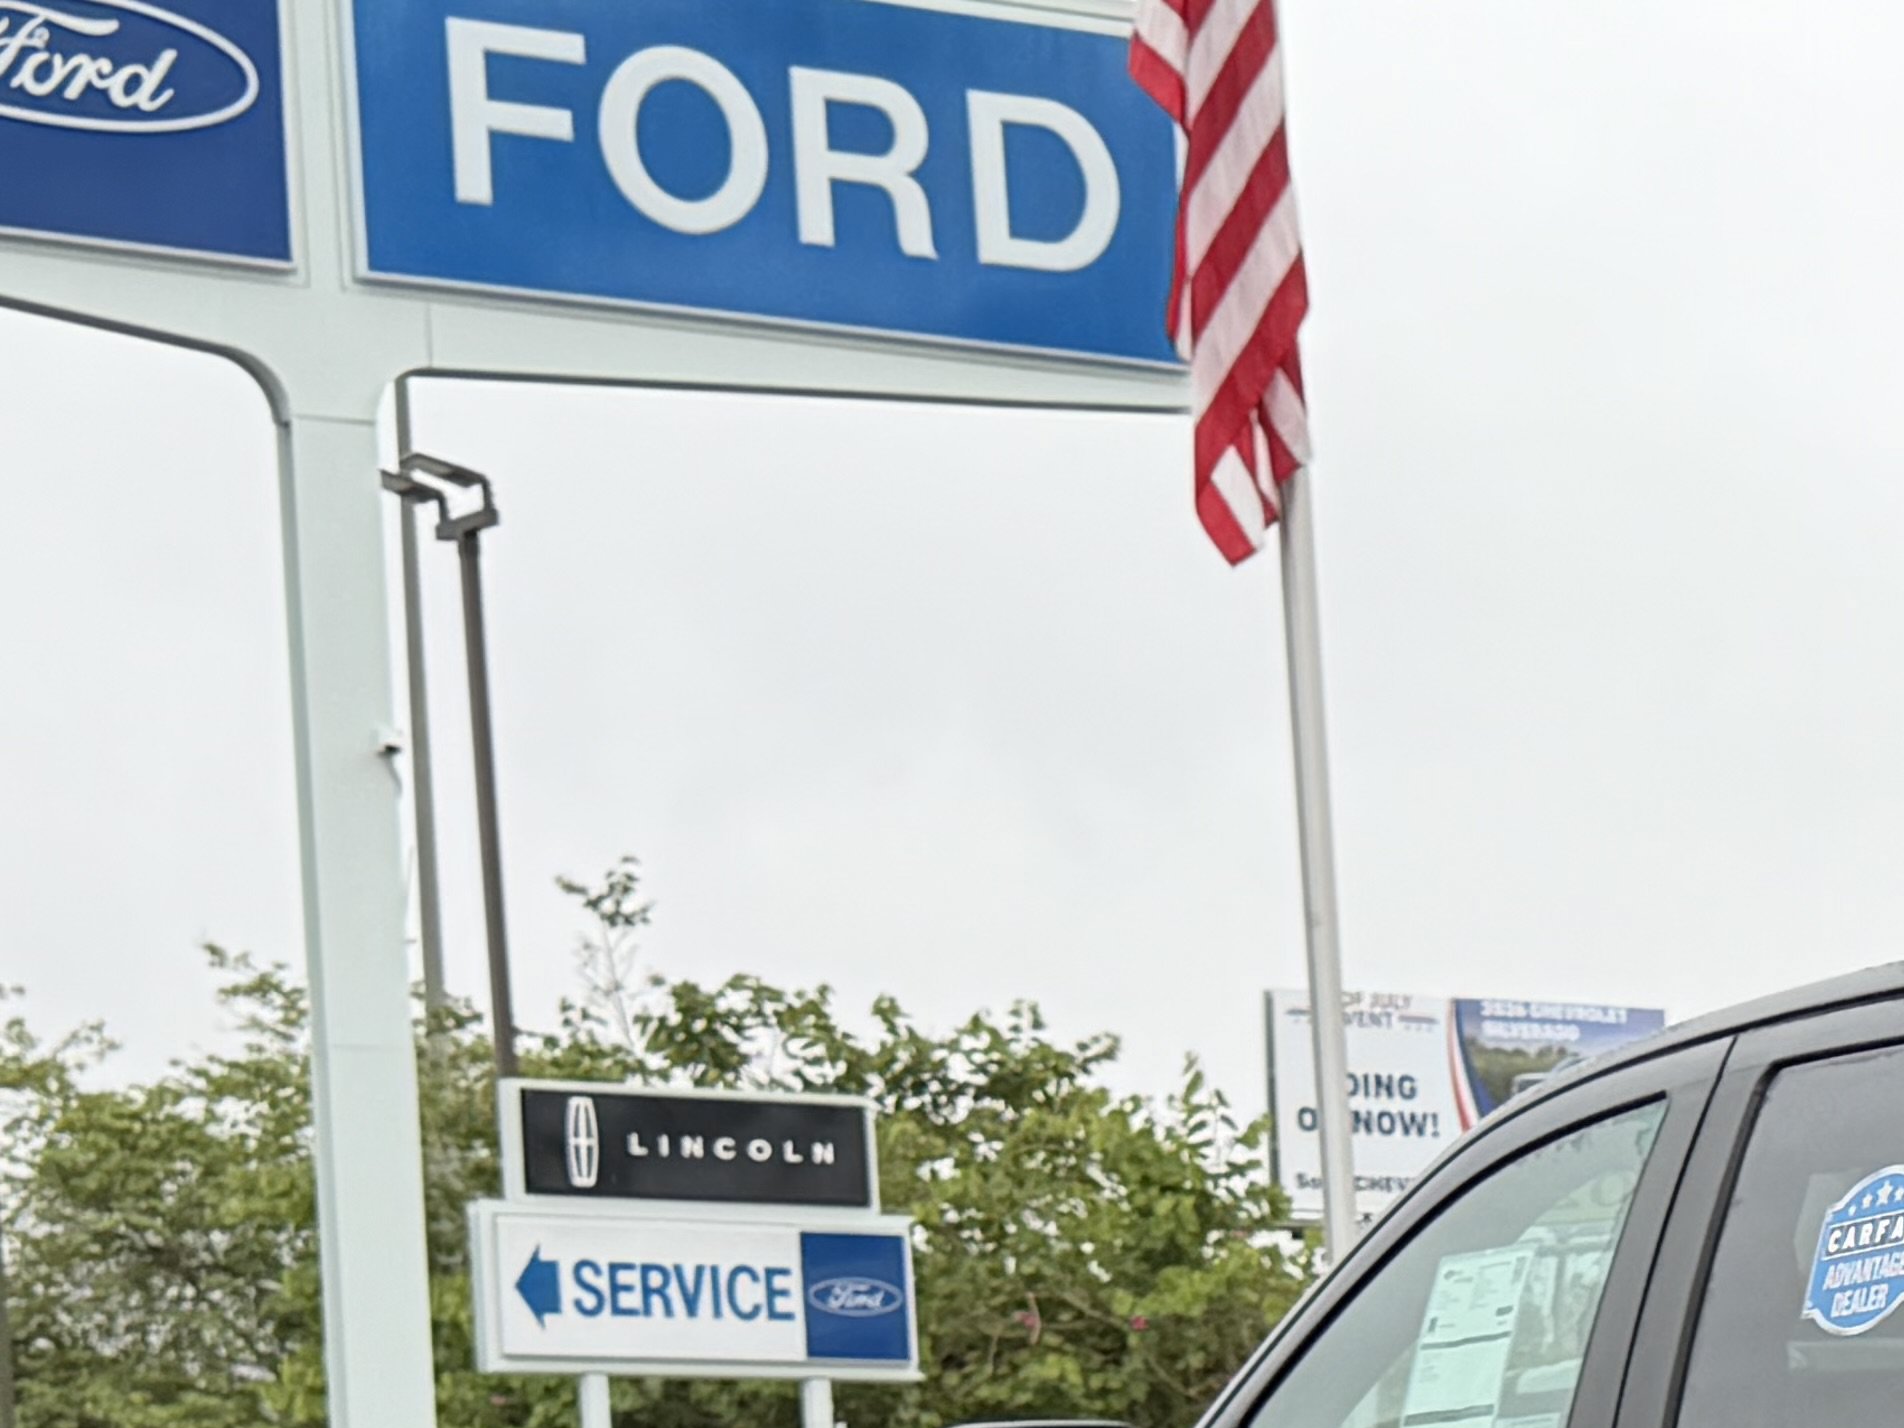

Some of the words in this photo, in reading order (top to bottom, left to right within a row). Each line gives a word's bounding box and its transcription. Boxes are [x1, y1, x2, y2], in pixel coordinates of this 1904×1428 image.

[445, 16, 1121, 272] FORD
[1351, 1110, 1441, 1138] NOW!
[627, 1131, 836, 1165] LINCOLN
[572, 1259, 797, 1322] SERVICE
[1830, 1284, 1889, 1318] DEALER
